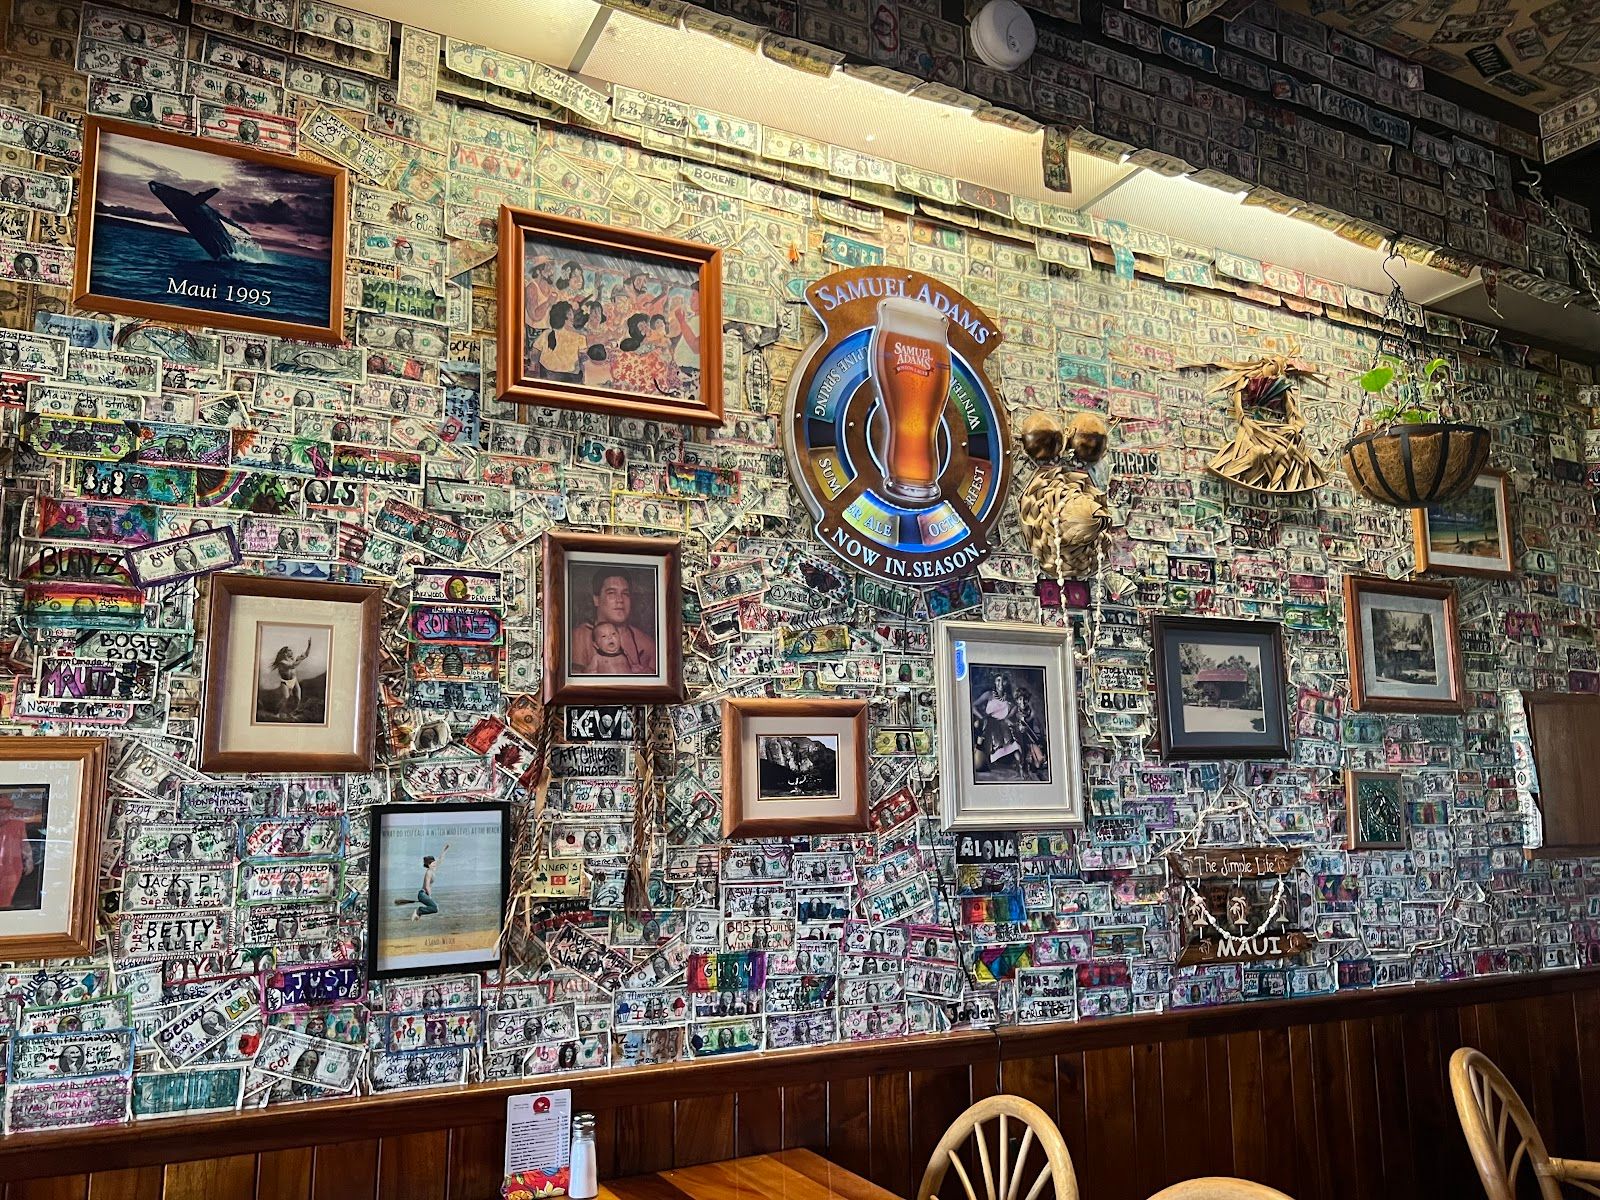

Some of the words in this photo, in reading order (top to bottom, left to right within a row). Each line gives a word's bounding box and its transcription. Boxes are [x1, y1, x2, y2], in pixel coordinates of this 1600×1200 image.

[166, 277, 218, 299] Maui
[225, 285, 272, 306] 1995
[817, 277, 913, 311] SAMUEL
[916, 282, 990, 345] ADAMS
[894, 341, 934, 361] SAMUEL
[897, 353, 931, 371] ADAMS
[814, 369, 843, 418] SPRING
[818, 458, 842, 495] SUM
[965, 466, 986, 511] RFEST
[863, 512, 893, 538] ALE
[928, 511, 961, 538] OCTO
[830, 526, 881, 567] NOW
[884, 560, 905, 577] IN
[960, 835, 1017, 861] ALOHA
[1193, 855, 1218, 876] The
[1220, 855, 1252, 877] Simple
[1254, 855, 1275, 876] Life
[146, 919, 215, 939] BETTY
[147, 940, 204, 951] KELLER
[1216, 936, 1283, 958] MAUI
[290, 968, 354, 991] JUST
[949, 998, 997, 1023] Jordan
